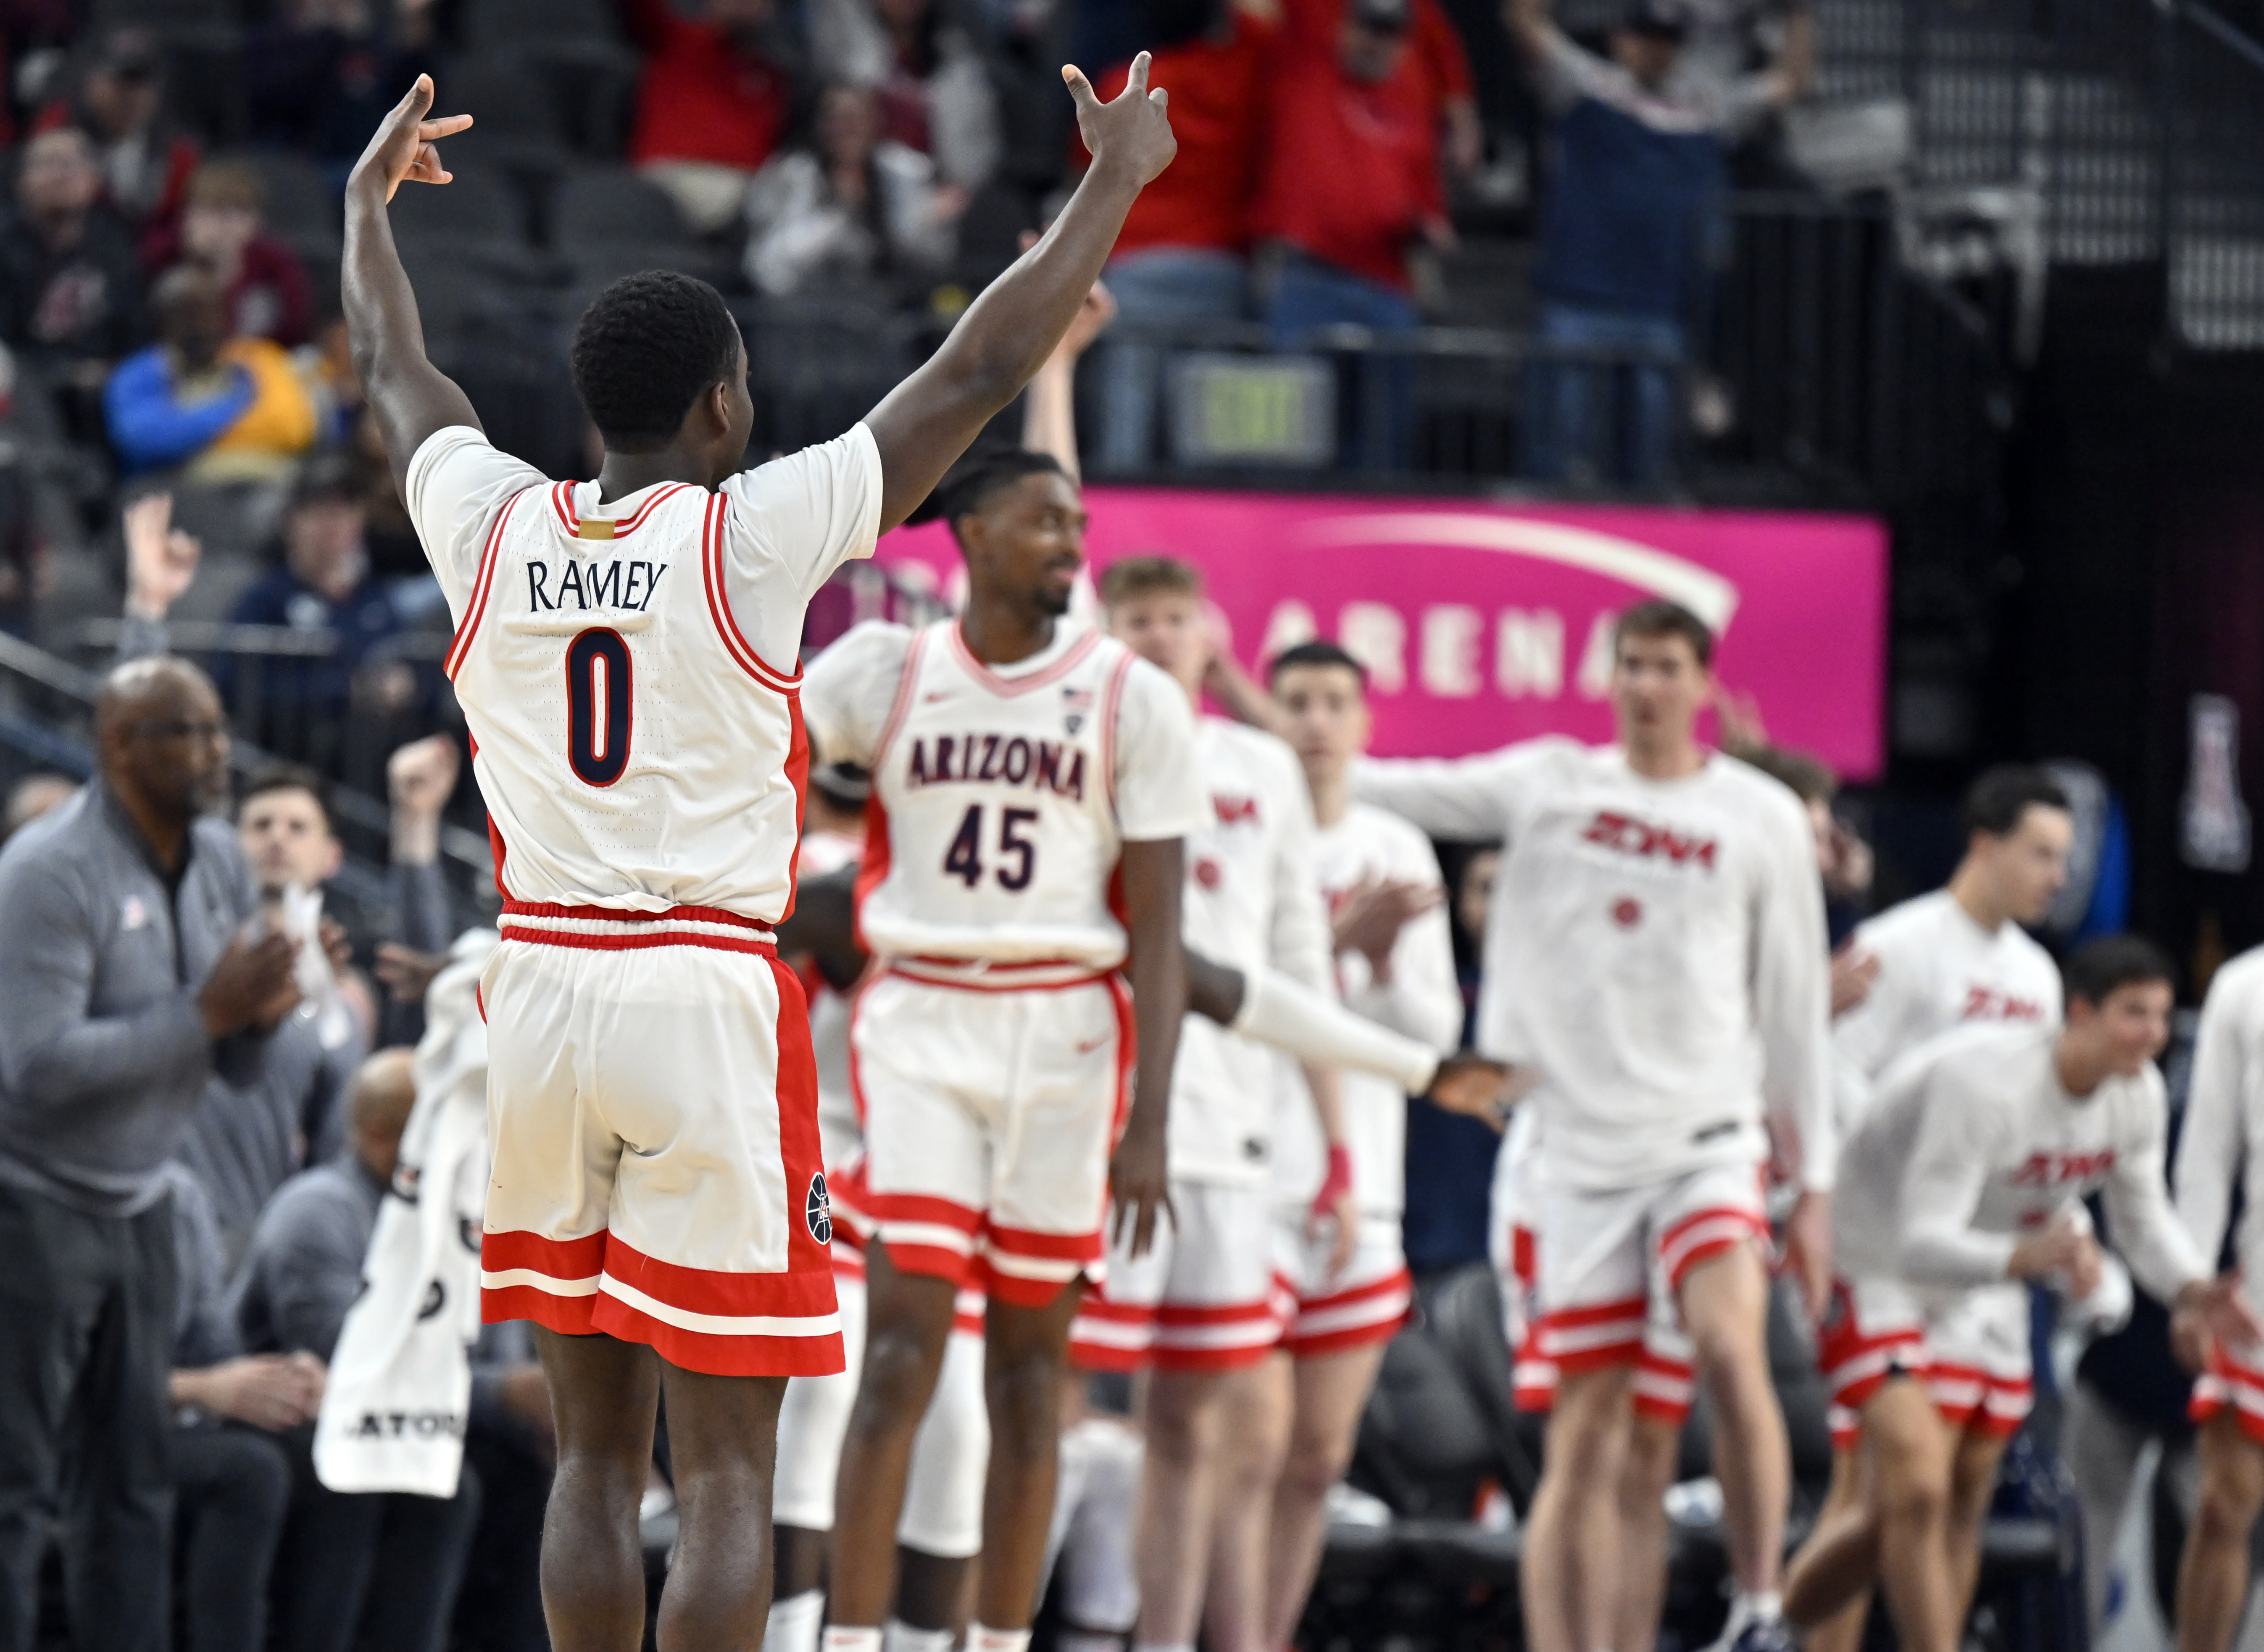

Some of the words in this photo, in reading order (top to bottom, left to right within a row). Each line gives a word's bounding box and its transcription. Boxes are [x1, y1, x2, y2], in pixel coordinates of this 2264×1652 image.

[527, 560, 667, 612] RAMEY
[565, 626, 632, 787] 0
[906, 733, 1084, 803] ARIZONA
[943, 804, 1038, 890] 45
